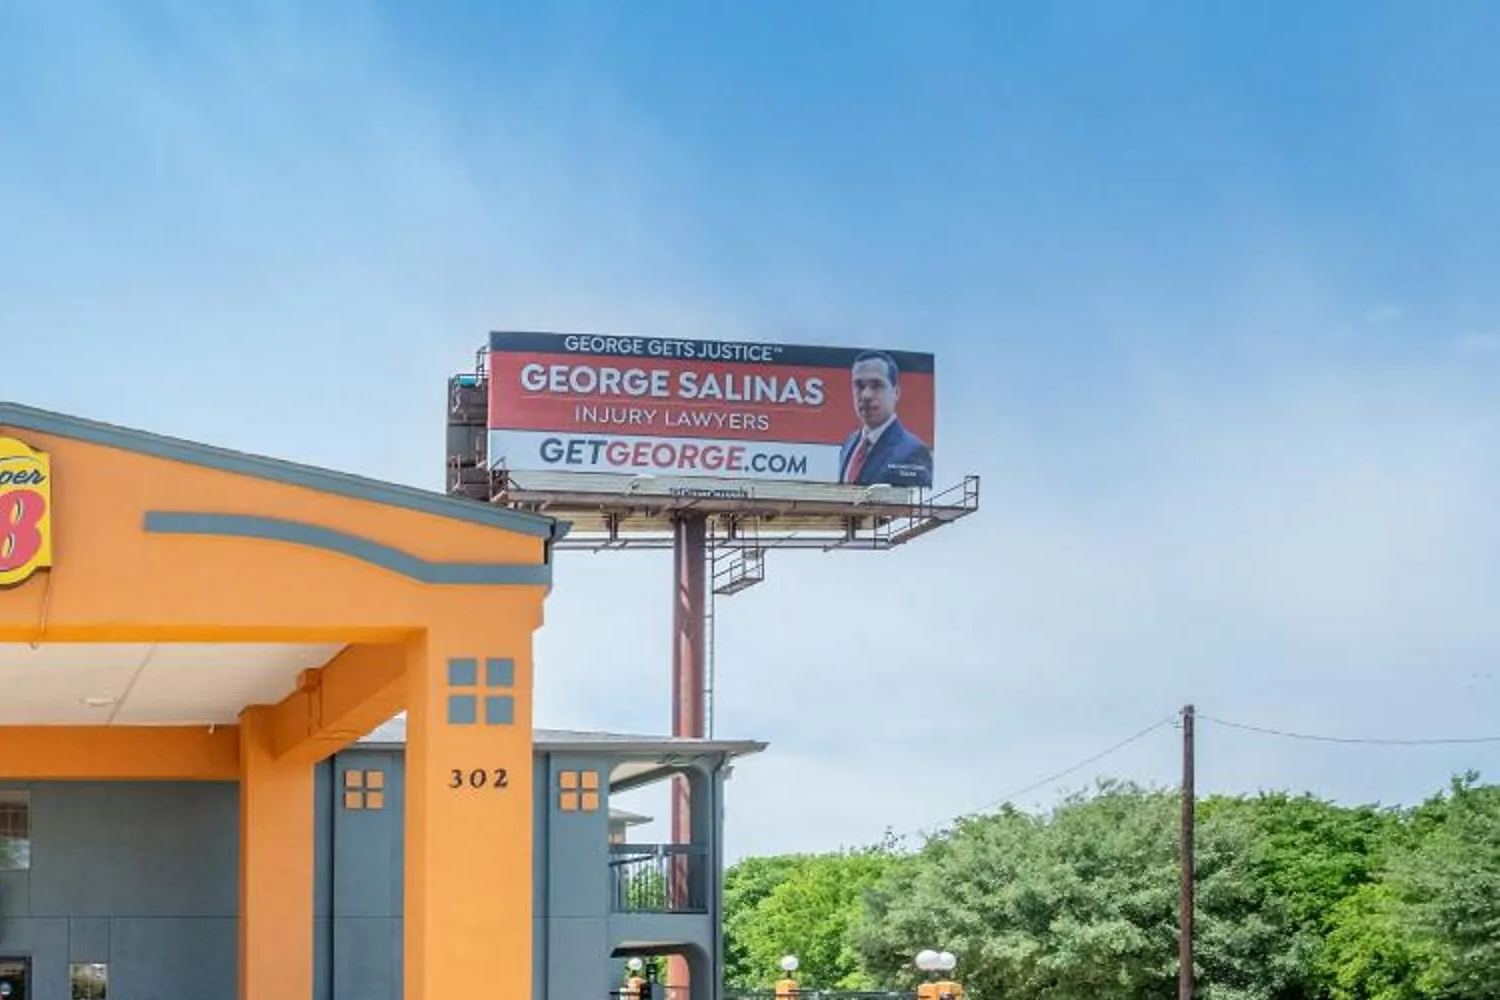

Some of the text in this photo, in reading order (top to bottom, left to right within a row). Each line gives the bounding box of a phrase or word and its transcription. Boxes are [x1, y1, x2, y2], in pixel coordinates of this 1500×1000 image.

[564, 335, 644, 355] GEORGE
[647, 339, 695, 357] GETS
[520, 363, 825, 405] GEORGE SALINAS
[574, 405, 770, 431] INJURY LAWYERS
[539, 437, 808, 474] GETGEORGE.COM
[448, 767, 508, 789] 302
